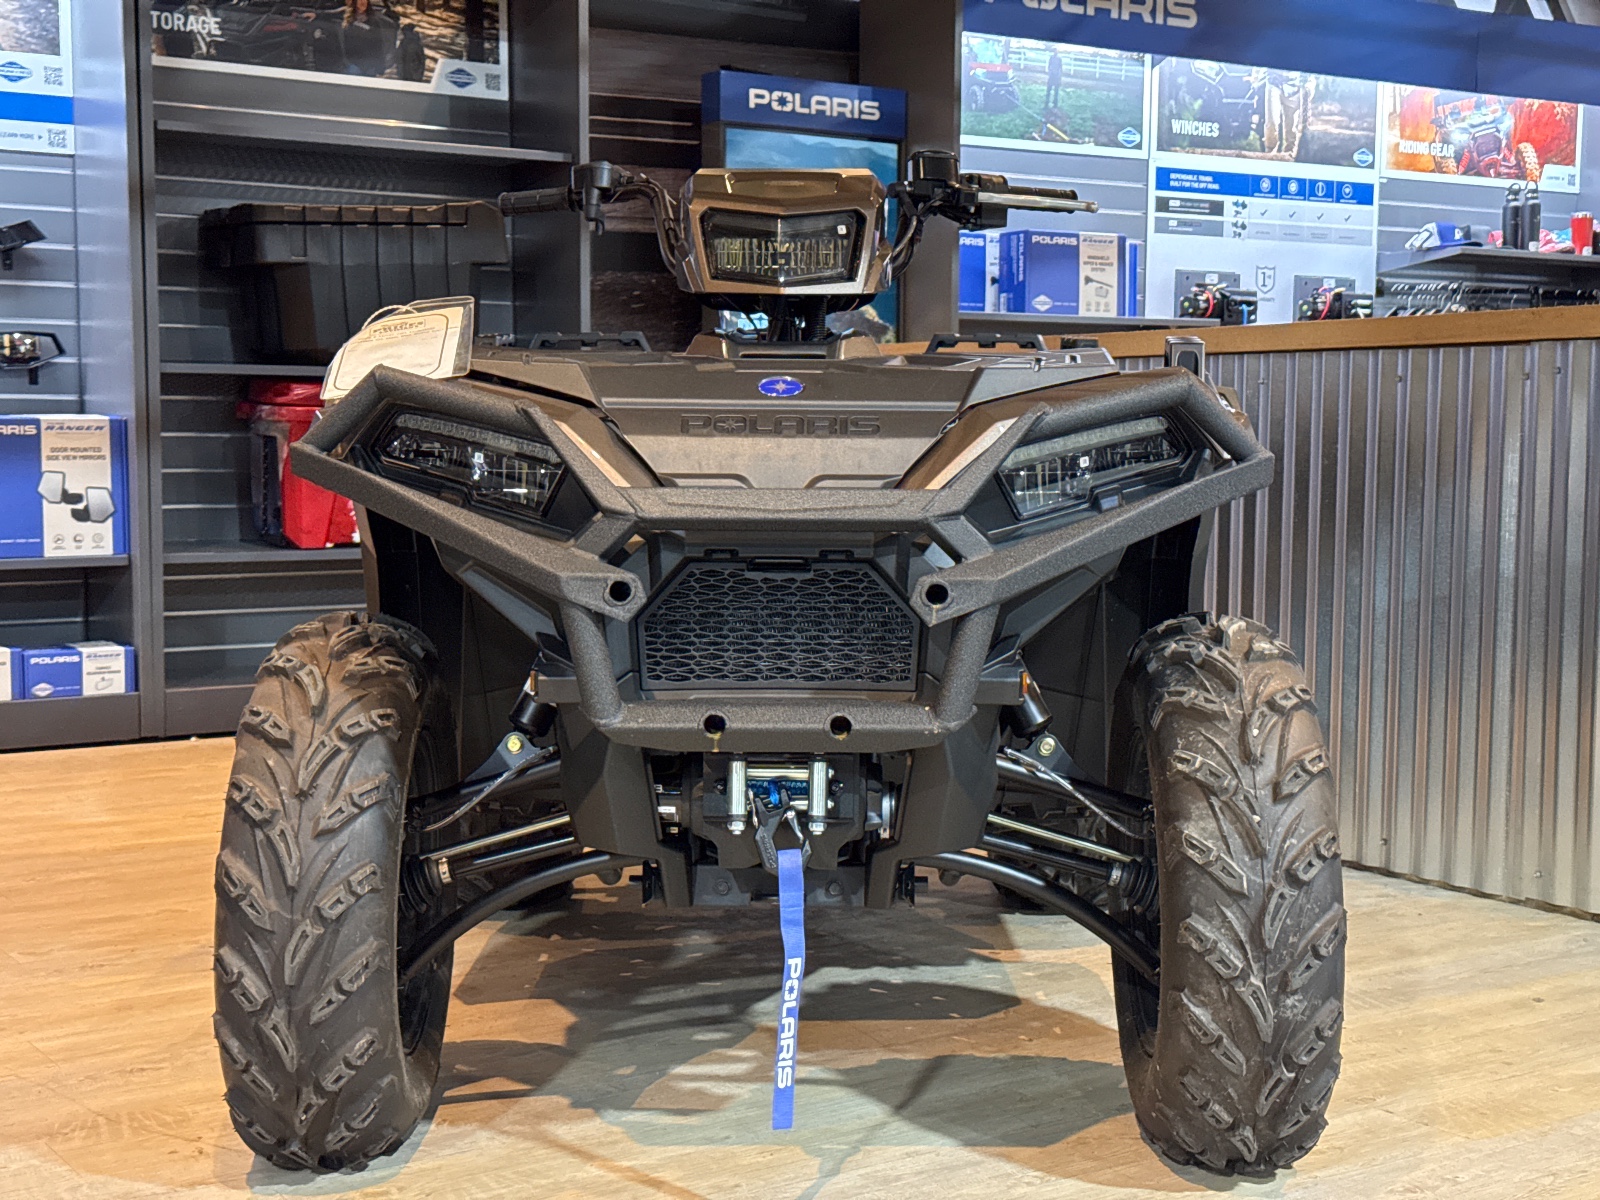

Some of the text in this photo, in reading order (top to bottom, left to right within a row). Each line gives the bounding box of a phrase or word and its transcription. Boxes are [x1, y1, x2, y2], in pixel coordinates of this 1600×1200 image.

[748, 88, 881, 121] POLARIS
[1171, 119, 1220, 138] WINCHES
[1399, 139, 1455, 158] RIDING GEAR
[1031, 235, 1078, 246] POLARIS
[680, 414, 881, 435] POLARIS
[30, 655, 80, 665] POLARIS
[777, 957, 802, 1089] POLARIS
